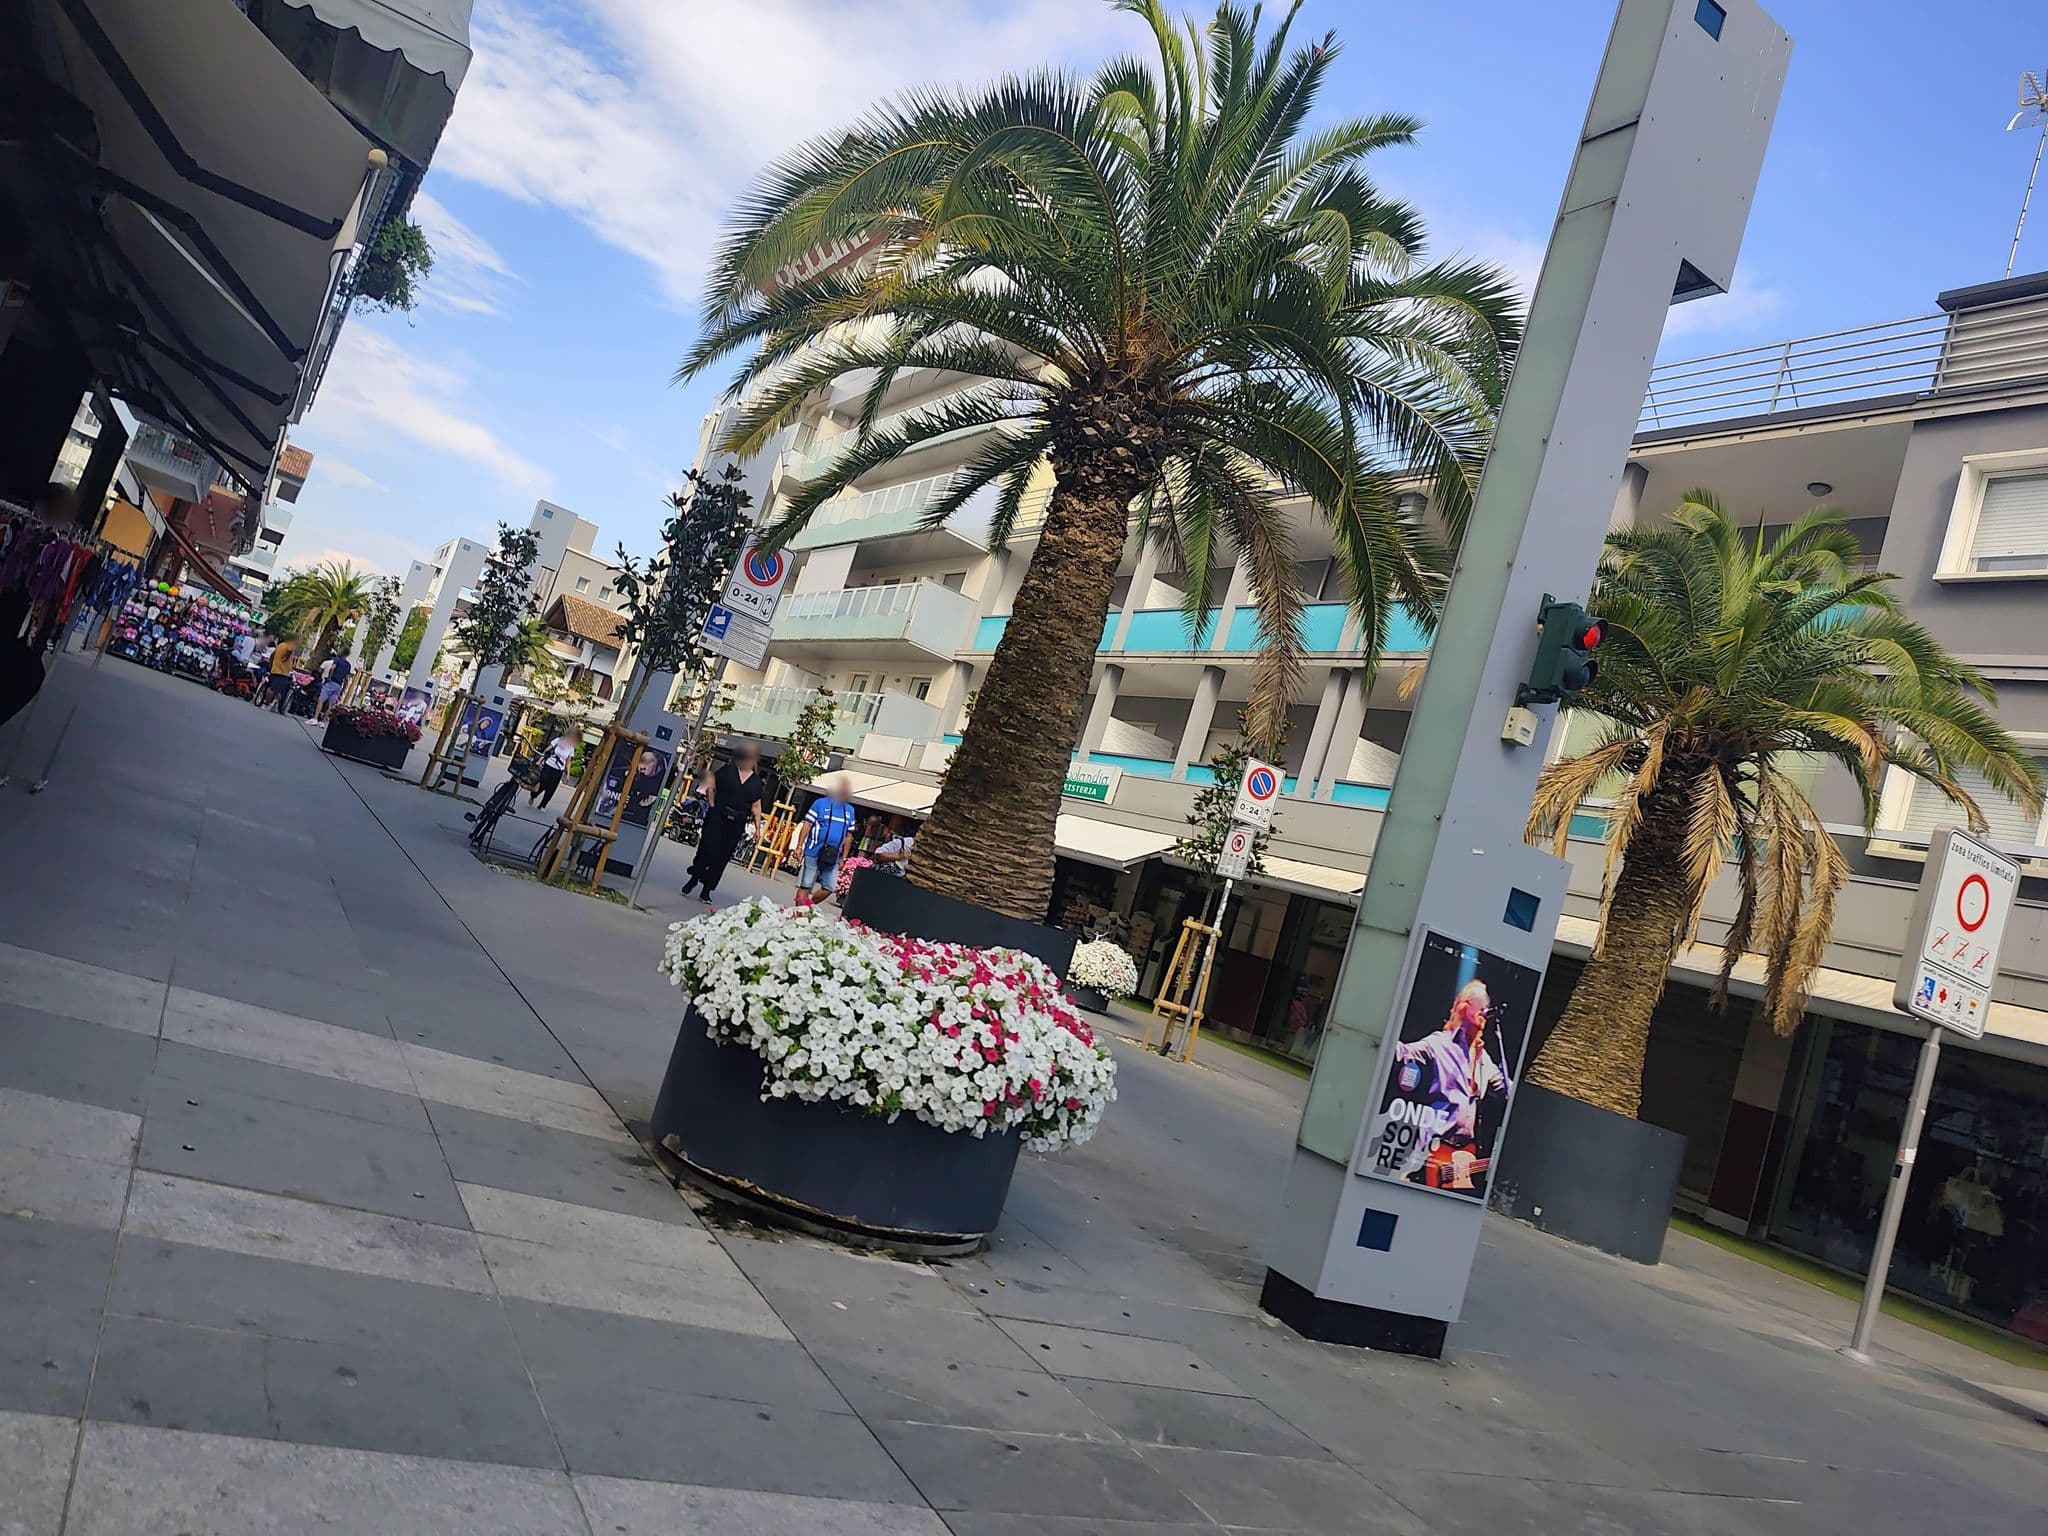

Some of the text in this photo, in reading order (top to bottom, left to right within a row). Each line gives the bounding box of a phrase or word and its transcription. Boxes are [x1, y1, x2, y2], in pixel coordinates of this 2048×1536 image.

[732, 588, 758, 605] 0-24
[1240, 803, 1259, 815] 0-24
[1951, 843, 1967, 857] zona
[1967, 848, 1990, 870] traffico
[1389, 1097, 1450, 1131] ONDE
[1376, 1143, 1406, 1171] RE
